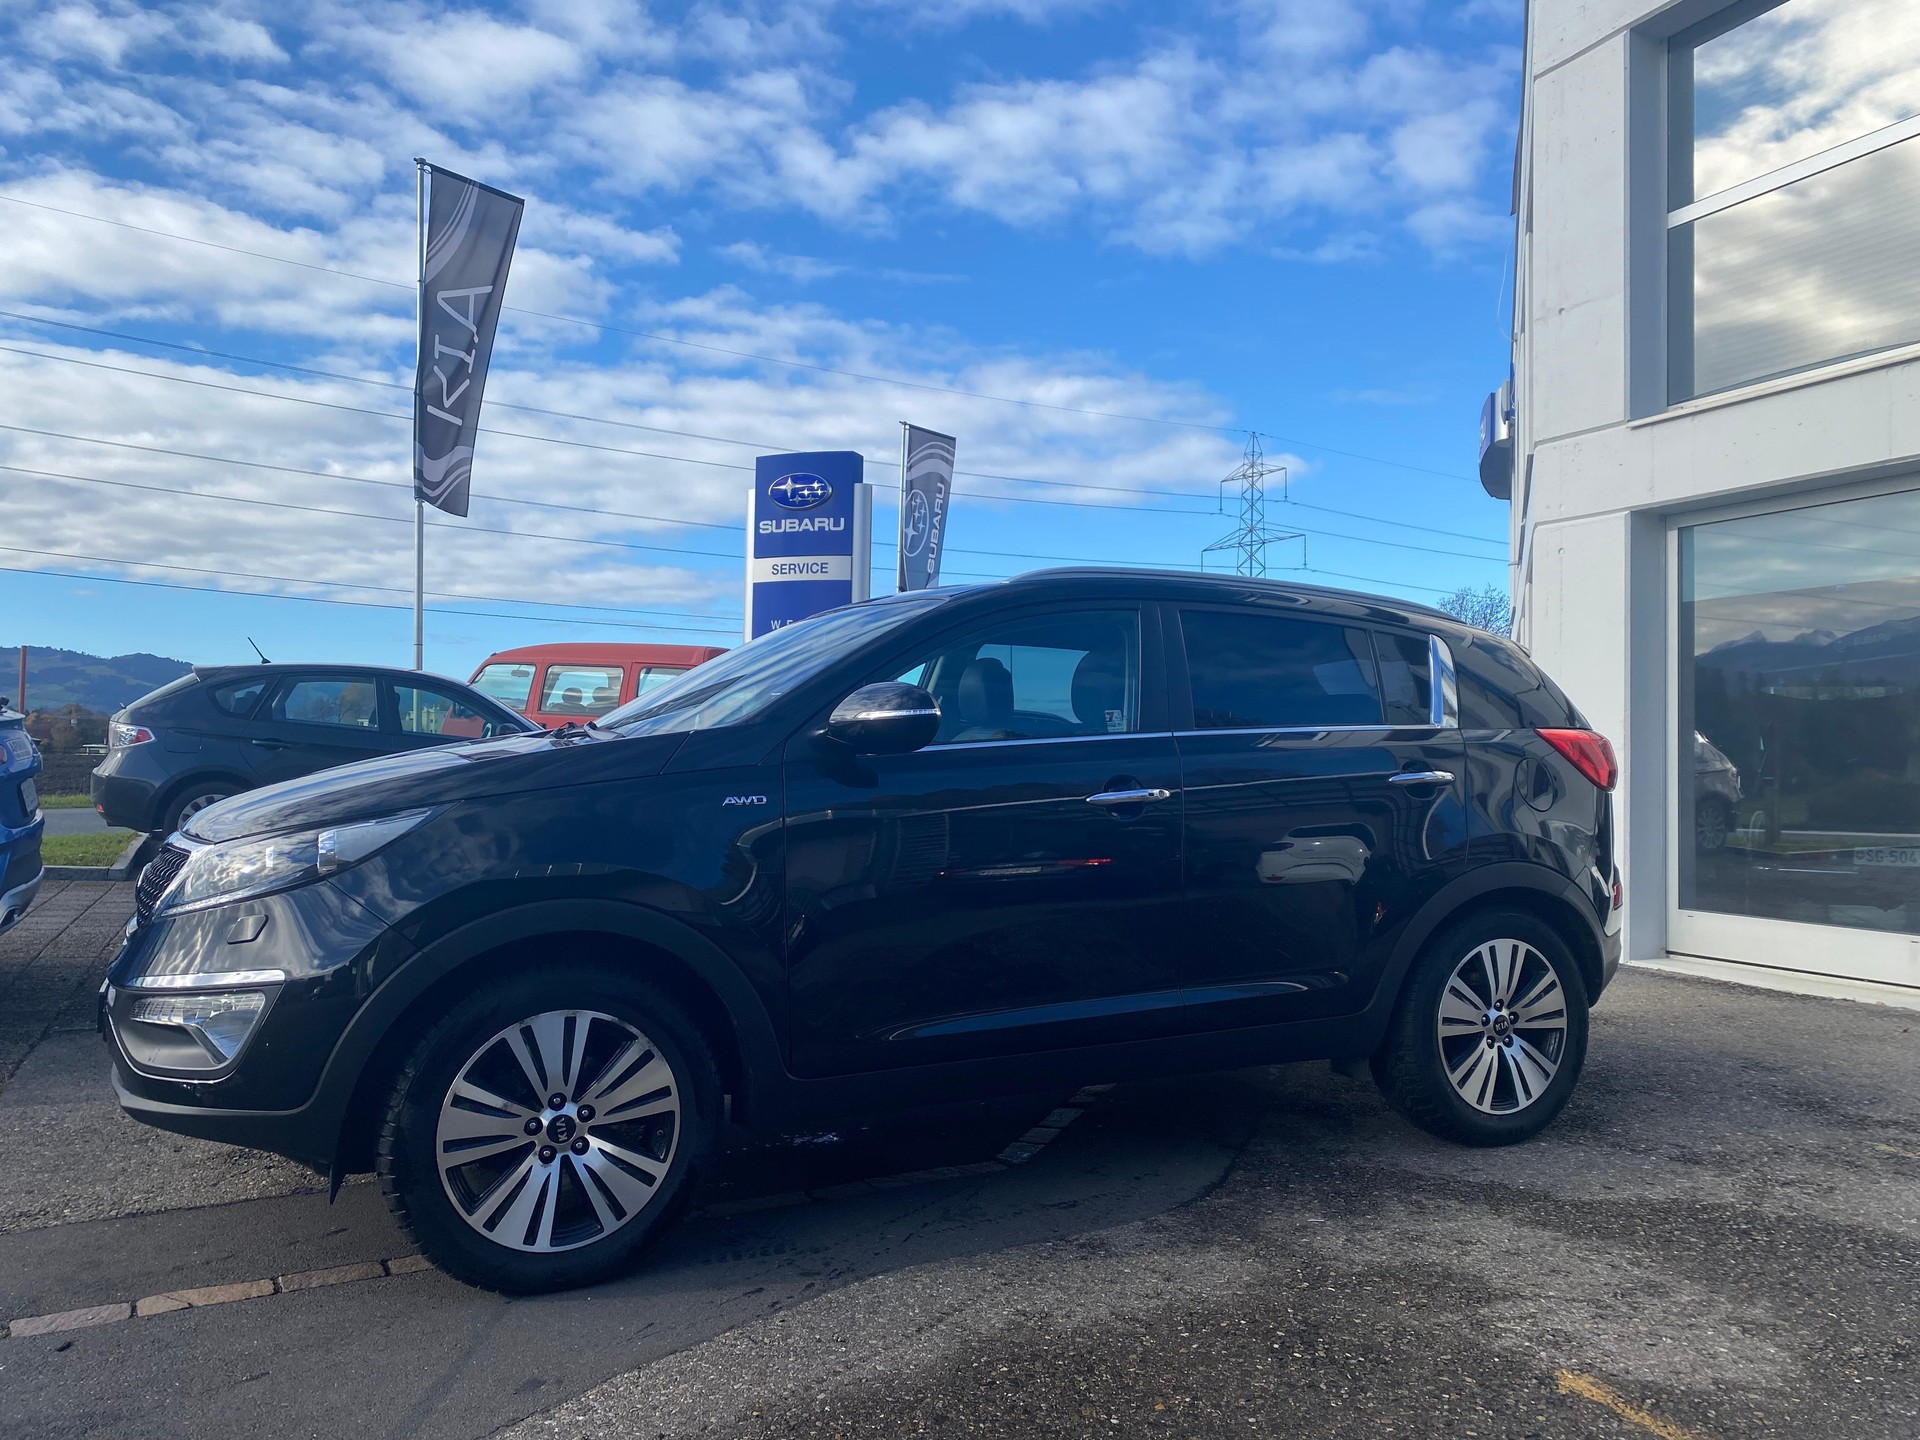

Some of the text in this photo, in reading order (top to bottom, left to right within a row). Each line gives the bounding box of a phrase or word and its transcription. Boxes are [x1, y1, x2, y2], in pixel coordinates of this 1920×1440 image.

[426, 285, 494, 427] KIA
[759, 517, 845, 534] SUBARU
[927, 482, 946, 574] SUBARU
[771, 562, 829, 575] SERVICE
[722, 795, 767, 807] AWD
[1495, 1021, 1509, 1031] KIA
[555, 1117, 568, 1142] KIA
